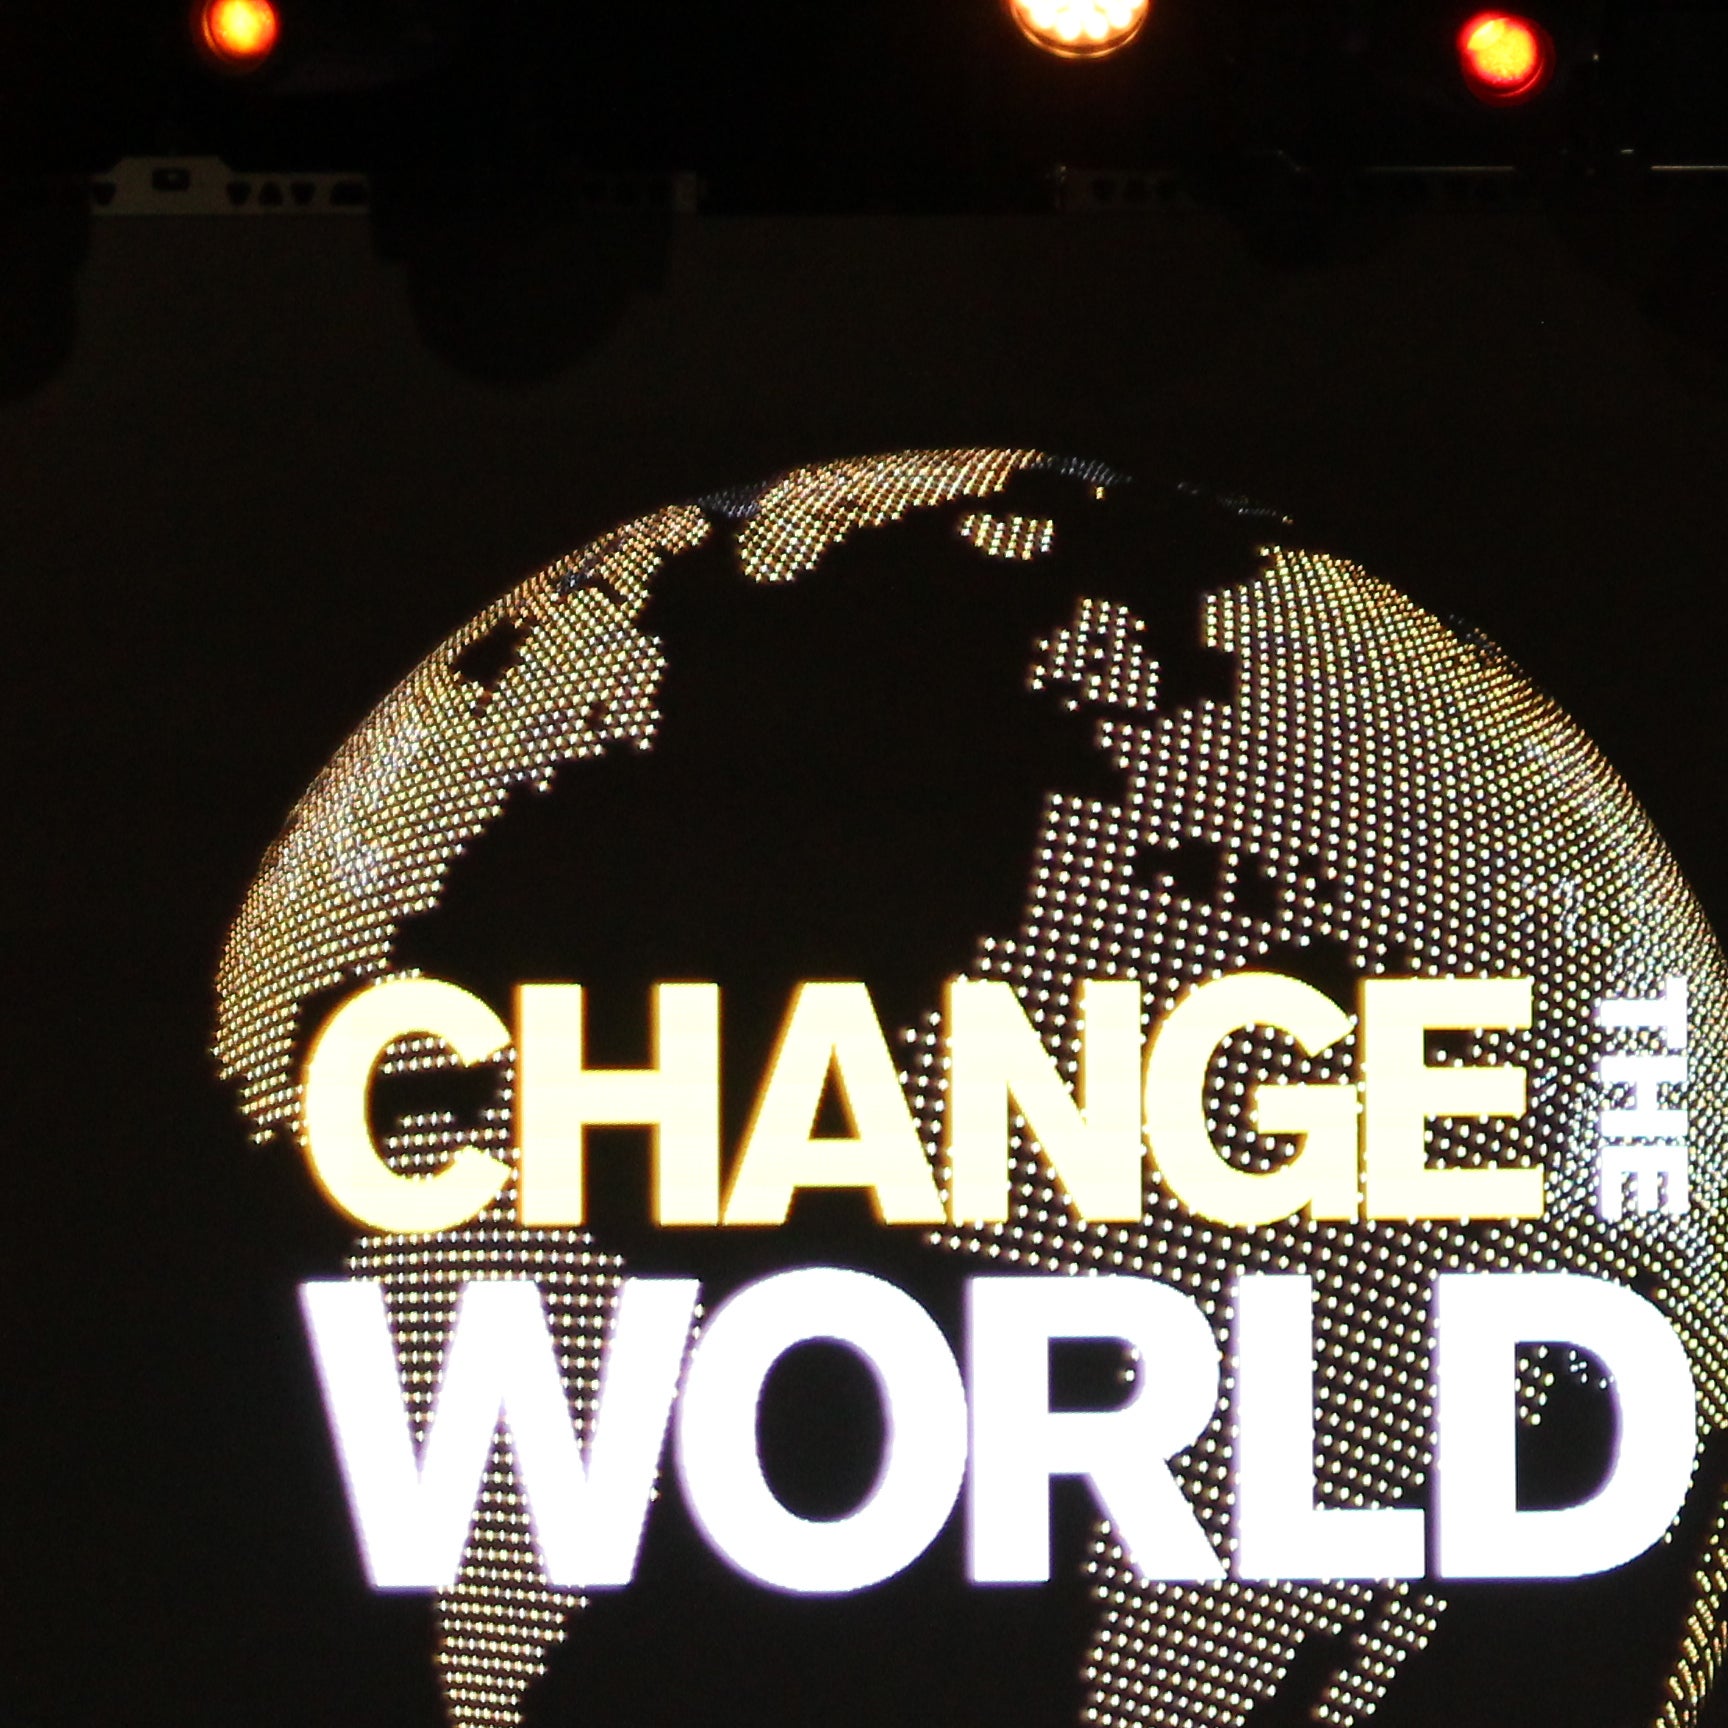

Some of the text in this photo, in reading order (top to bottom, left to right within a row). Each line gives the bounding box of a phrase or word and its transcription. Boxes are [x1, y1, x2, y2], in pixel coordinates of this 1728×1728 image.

[298, 969, 1545, 1232] CHANGE
[1600, 975, 1690, 1220] THE
[300, 1264, 1700, 1593] WORLD
